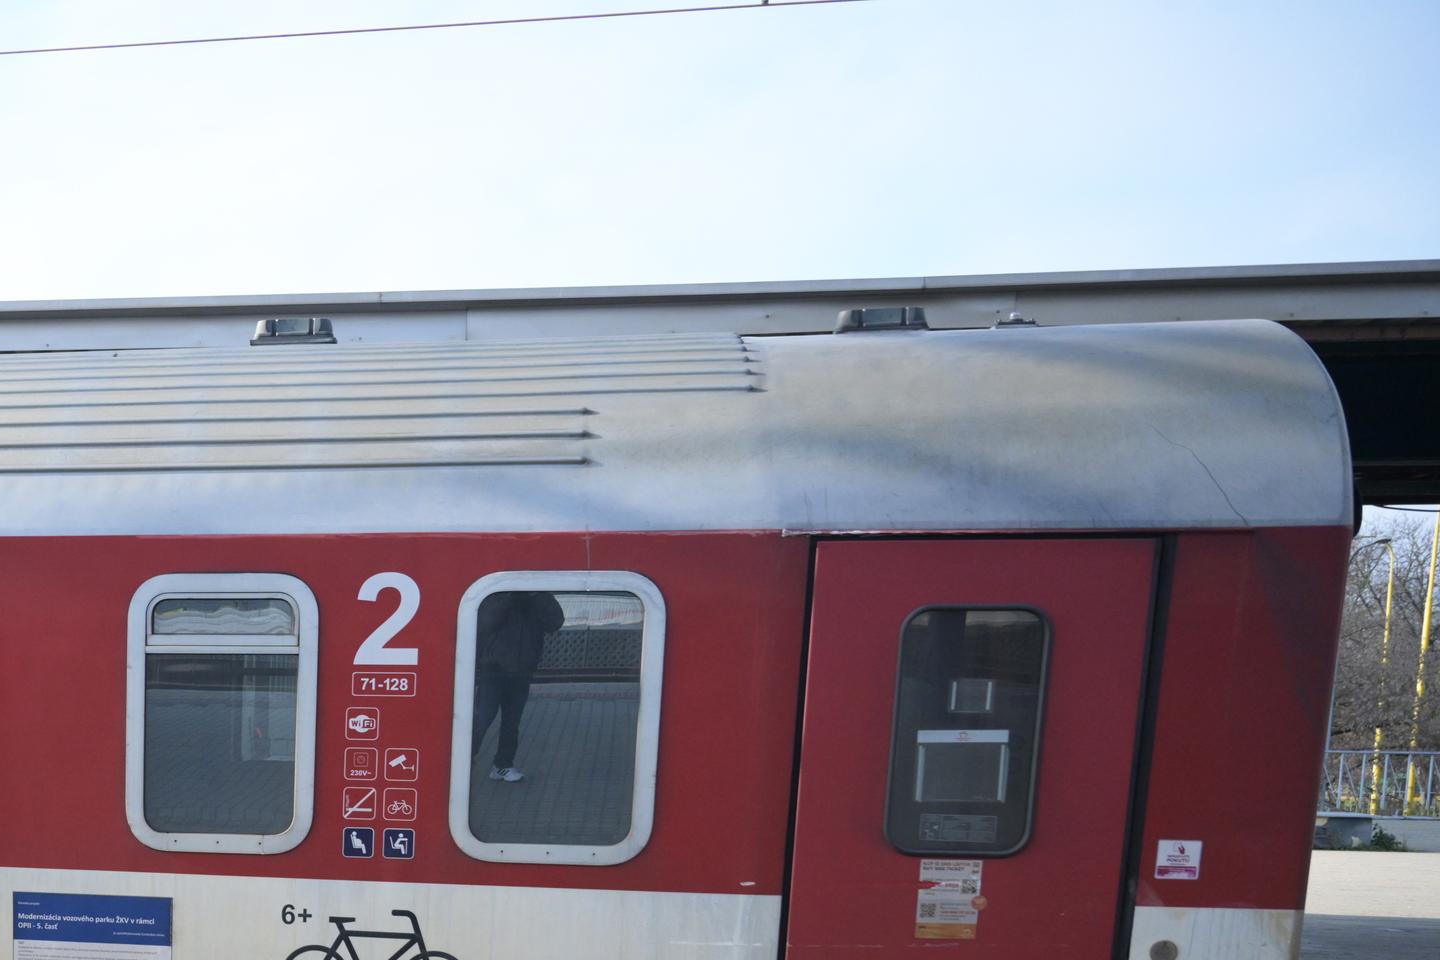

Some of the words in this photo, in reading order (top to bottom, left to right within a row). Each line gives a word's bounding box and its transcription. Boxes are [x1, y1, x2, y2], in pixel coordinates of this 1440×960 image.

[353, 571, 421, 665] 2
[360, 677, 408, 691] 71-128
[136, 917, 155, 925] rámci
[281, 904, 312, 924] 6+
